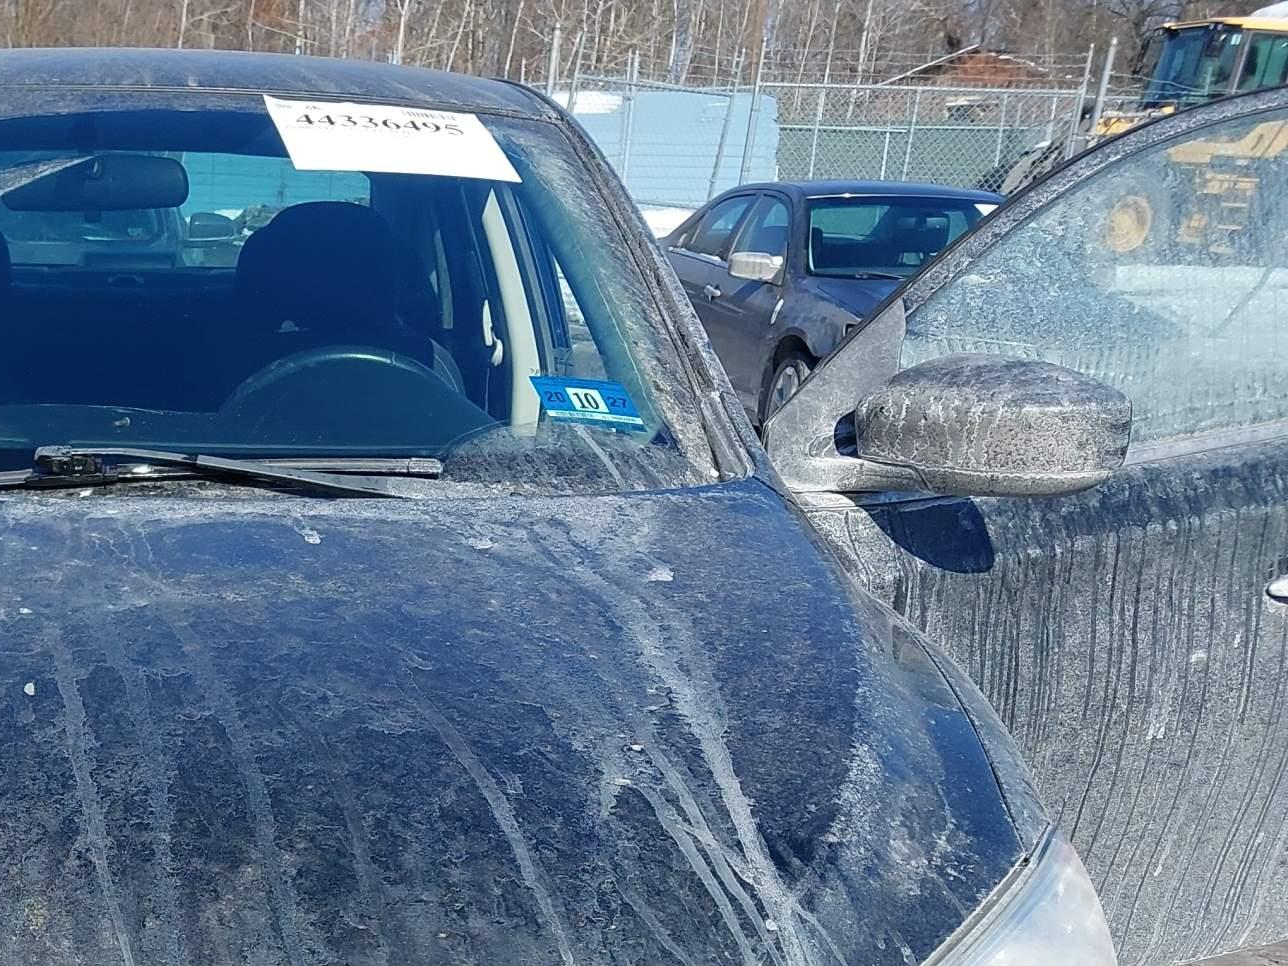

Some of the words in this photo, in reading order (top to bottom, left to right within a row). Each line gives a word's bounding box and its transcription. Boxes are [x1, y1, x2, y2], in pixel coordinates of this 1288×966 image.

[296, 113, 464, 136] 44336495
[543, 391, 566, 403] 20
[573, 392, 599, 410] 10
[607, 396, 627, 409] 27
